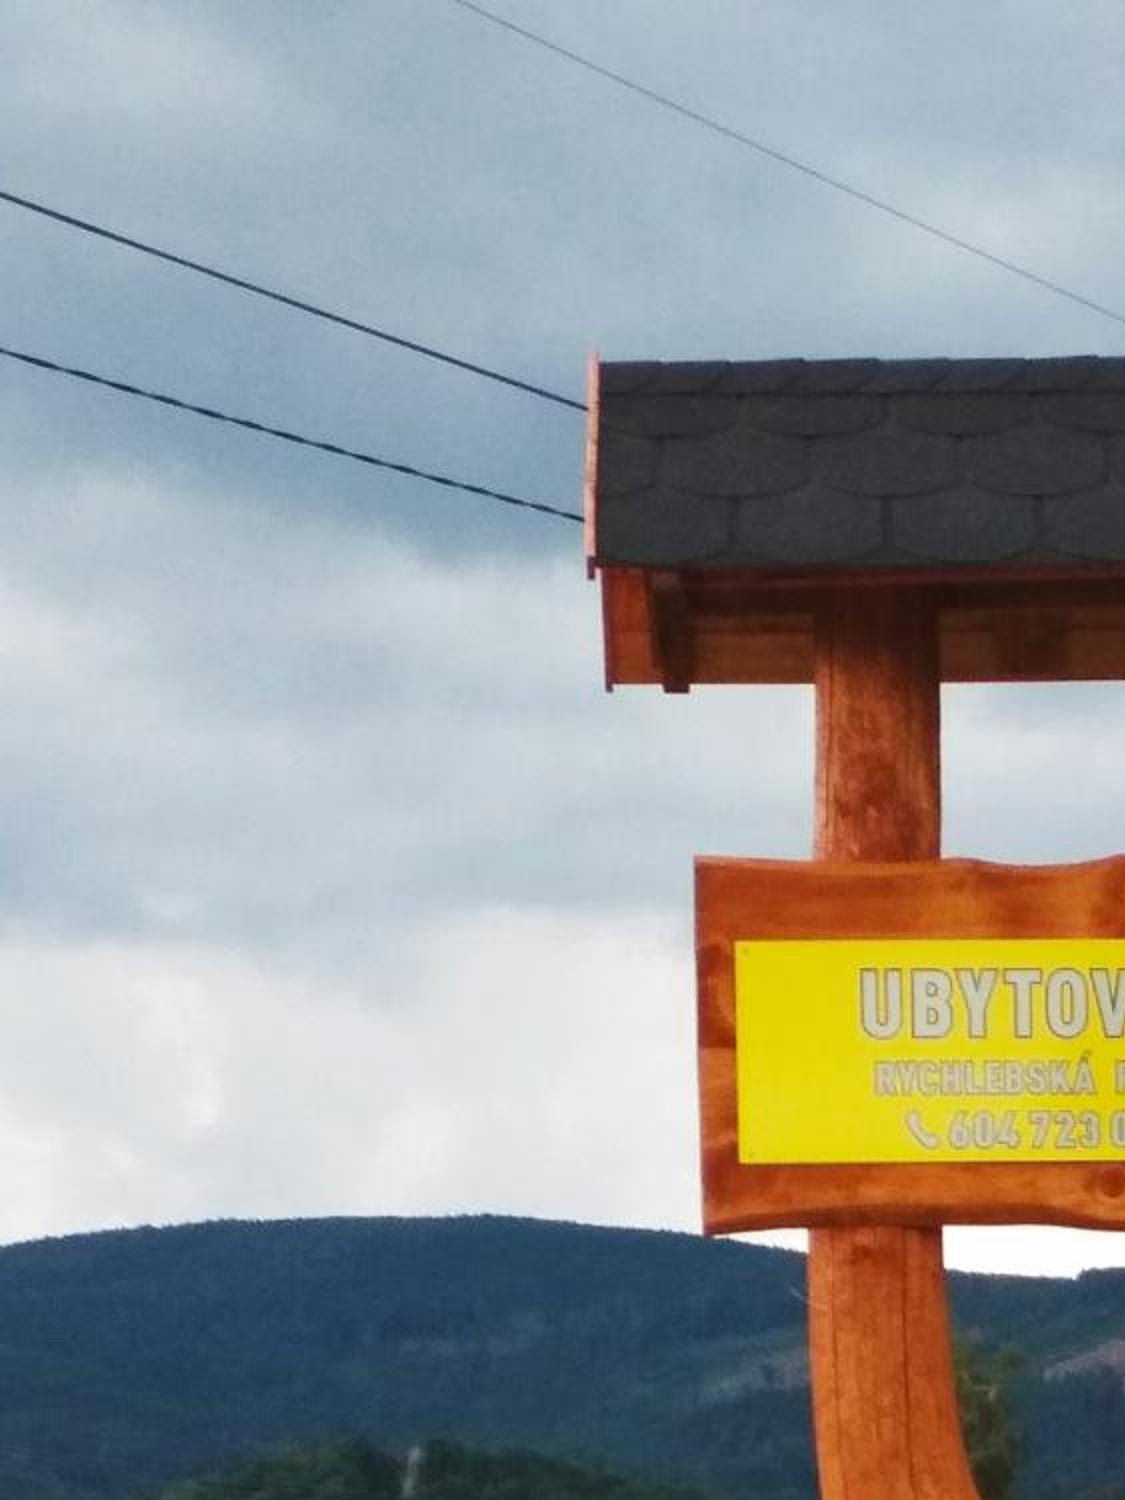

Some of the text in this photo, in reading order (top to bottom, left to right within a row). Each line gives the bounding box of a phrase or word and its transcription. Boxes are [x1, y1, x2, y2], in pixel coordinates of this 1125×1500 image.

[874, 1050, 1096, 1095] RYCHLEBSKÁ
[948, 1110, 1022, 1149] 604
[1028, 1110, 1101, 1149] 723
